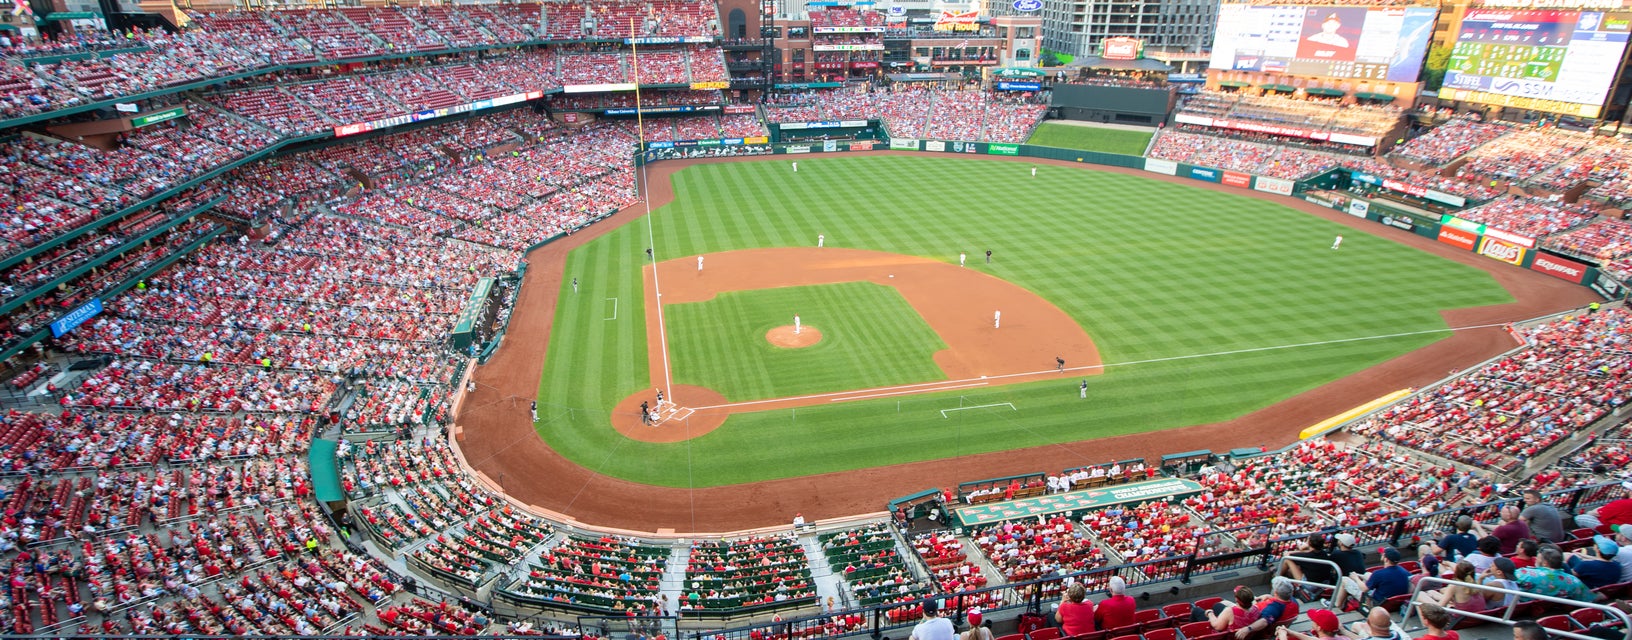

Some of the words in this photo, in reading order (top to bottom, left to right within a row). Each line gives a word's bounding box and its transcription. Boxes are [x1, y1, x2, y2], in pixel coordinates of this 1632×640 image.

[940, 14, 975, 23] Budweiser
[934, 23, 954, 31] BREW
[955, 22, 980, 31] HOUSE
[1353, 67, 1363, 78] 2
[1365, 68, 1373, 79] 1
[1376, 69, 1386, 80] 2
[1453, 74, 1482, 87] STIFEL
[1524, 82, 1554, 96] SSM
[1484, 238, 1520, 259] Lay's
[1535, 259, 1580, 277] EQUIFAX
[66, 301, 96, 321] SITEMAN
